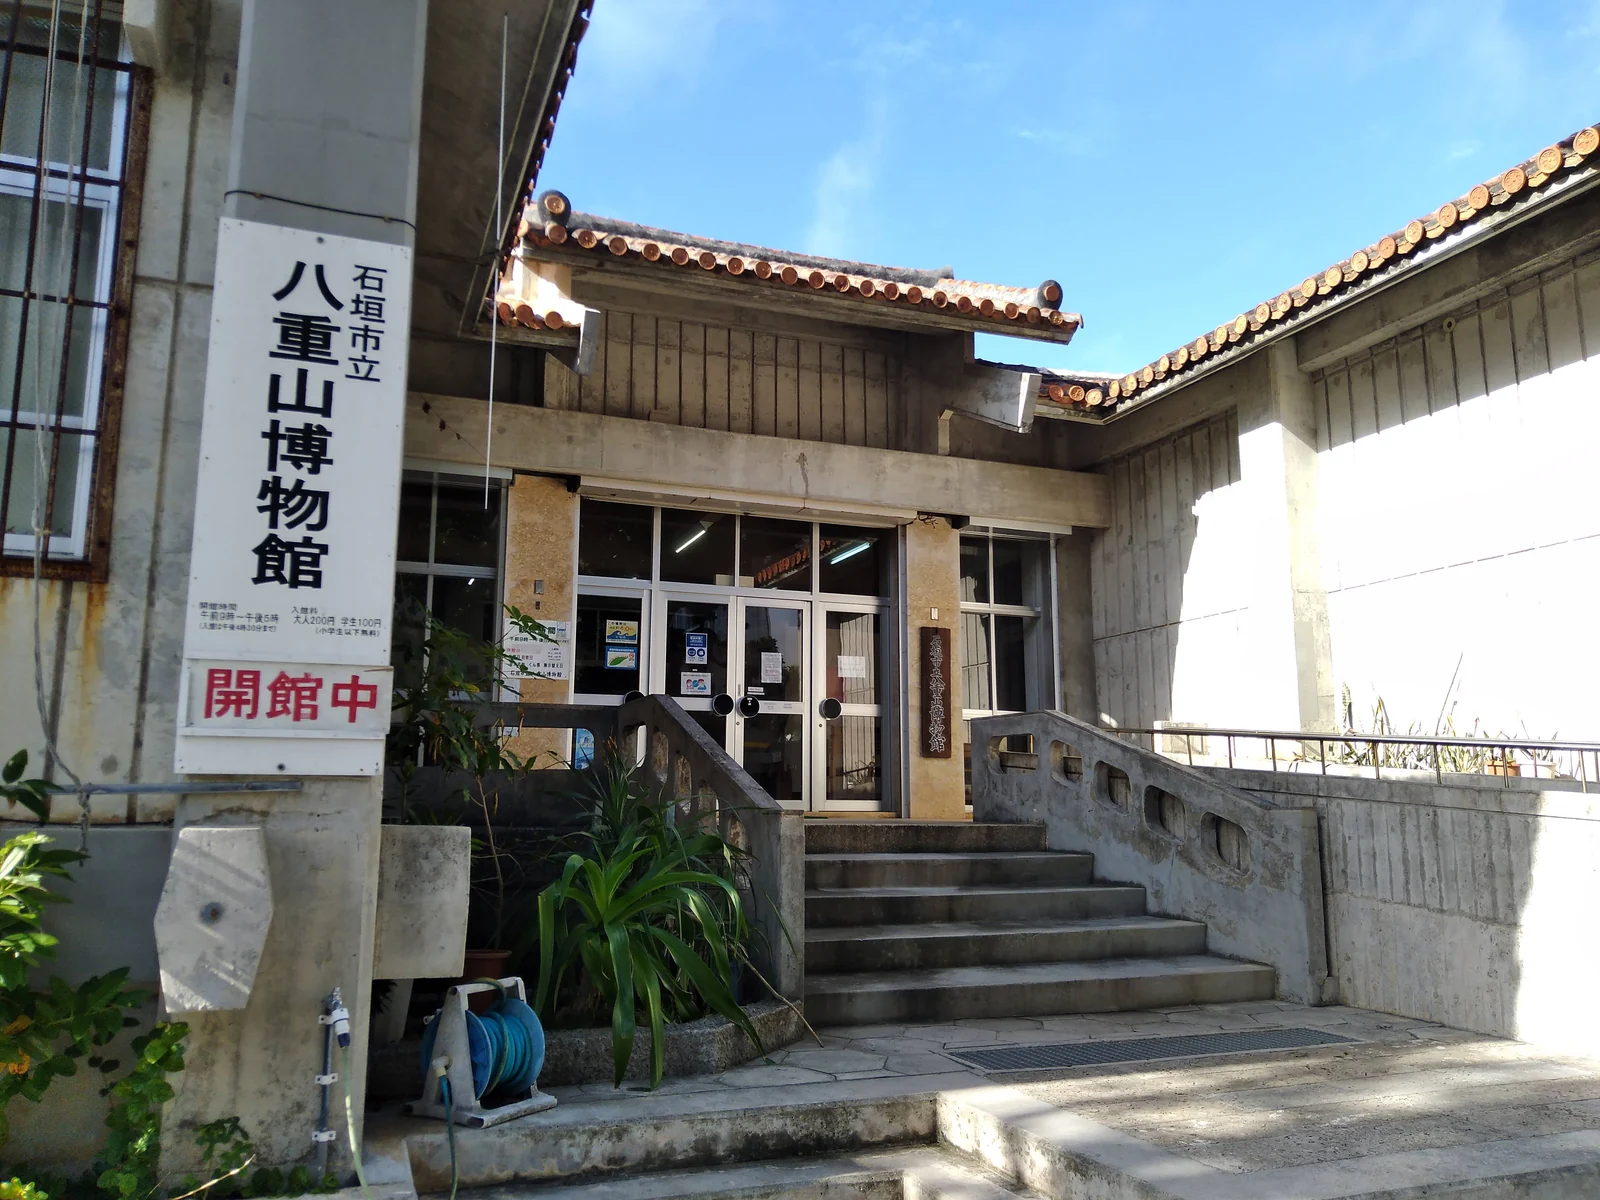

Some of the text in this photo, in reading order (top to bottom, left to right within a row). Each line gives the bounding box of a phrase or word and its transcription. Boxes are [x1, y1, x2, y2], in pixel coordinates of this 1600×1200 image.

[345, 264, 387, 383] 石垣市立
[251, 260, 345, 589] 八重山博物館
[198, 601, 237, 611] 開館時間
[291, 606, 319, 615] 入館料
[293, 615, 382, 628] 大人200円 学生100円
[203, 668, 378, 724] 開館中
